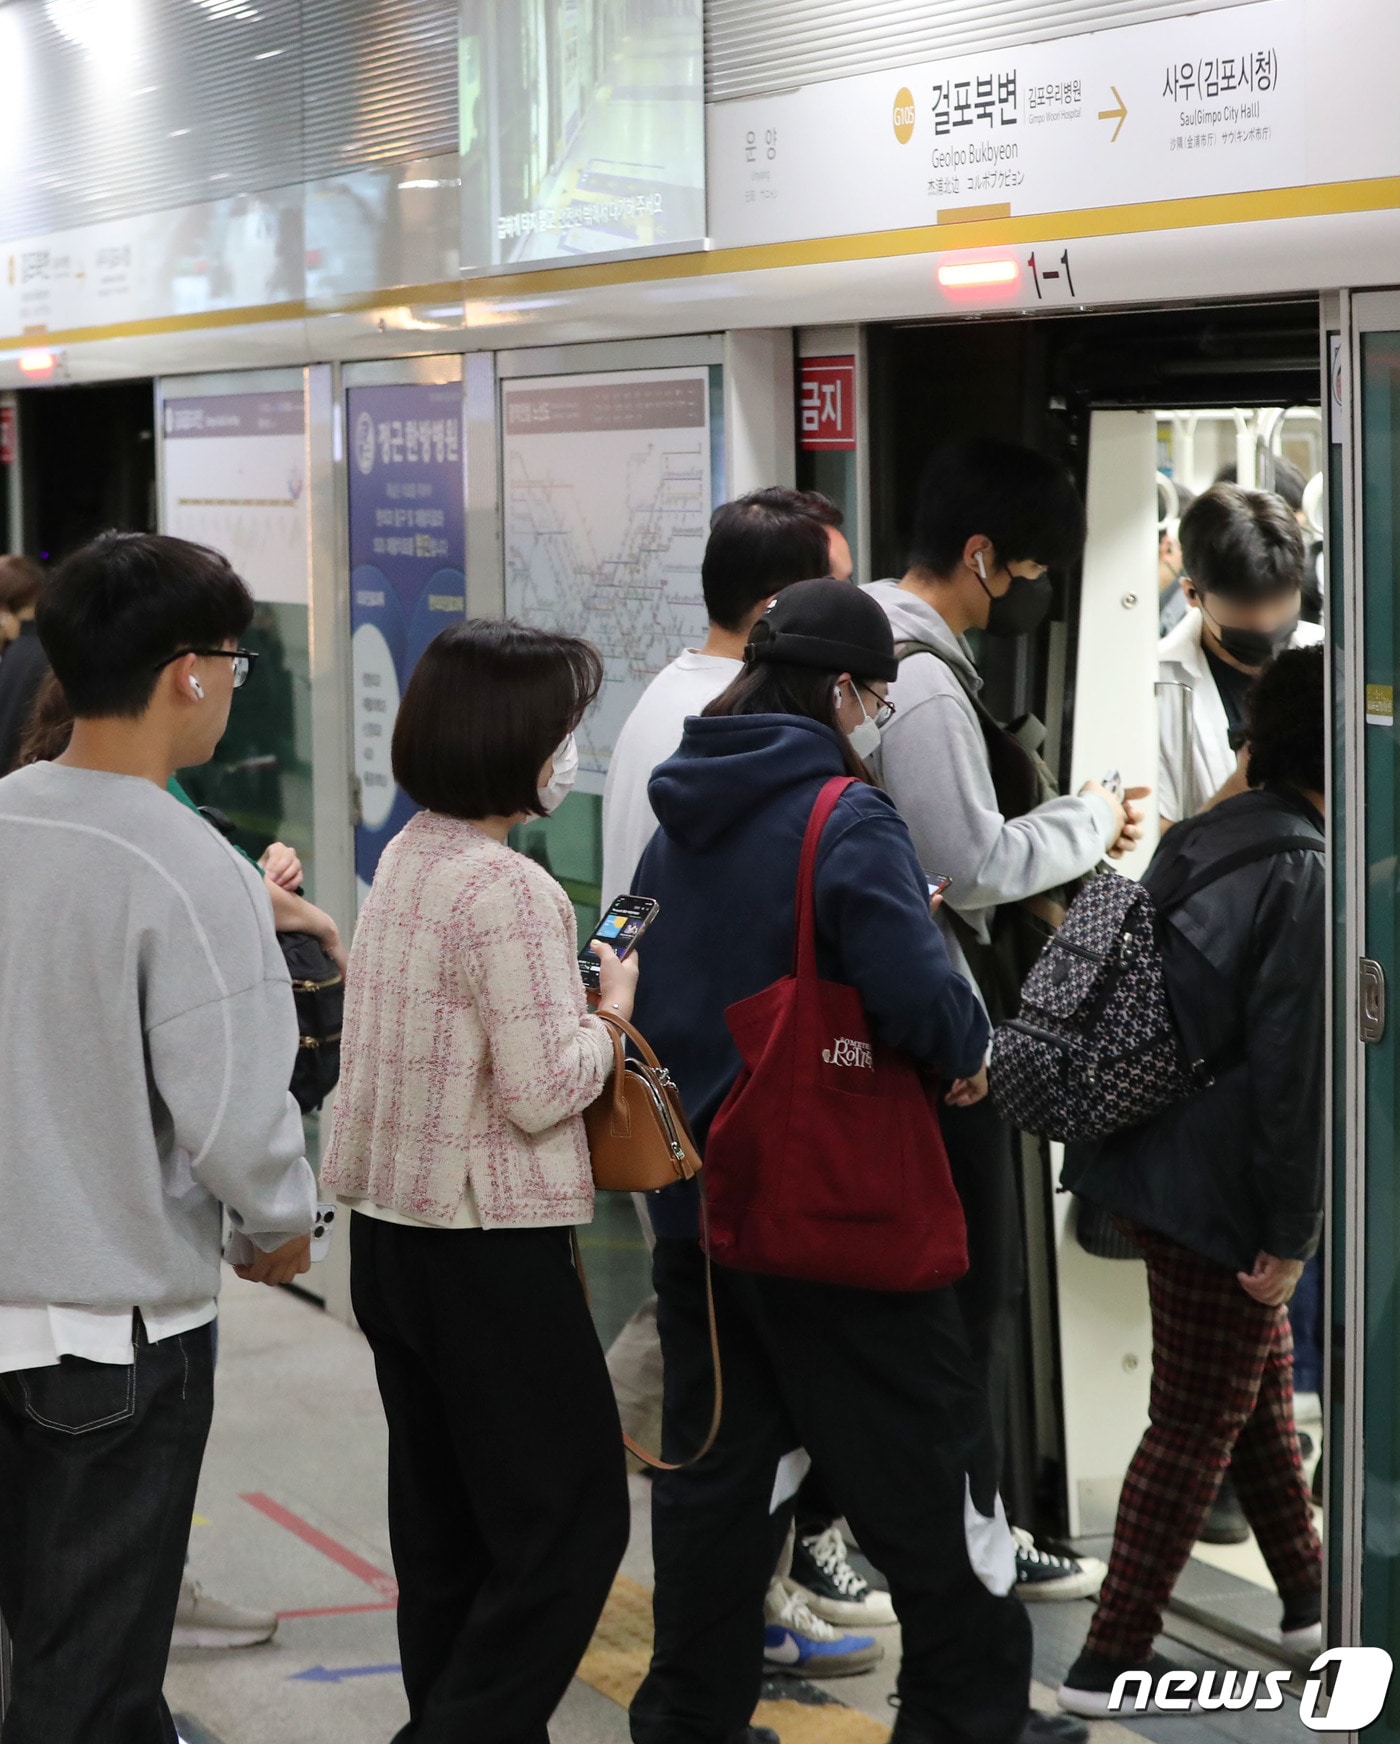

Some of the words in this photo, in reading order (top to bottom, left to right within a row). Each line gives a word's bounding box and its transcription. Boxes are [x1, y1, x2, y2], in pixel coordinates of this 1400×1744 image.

[1028, 79, 1082, 109] 김포우리병원
[1162, 47, 1278, 103] 사우(김포시청)
[894, 105, 916, 127] G105
[931, 68, 1018, 136] 걸포북변
[1223, 105, 1239, 124] City
[931, 145, 967, 172] Geolpo
[968, 140, 1019, 167] Bukbyeon
[1027, 248, 1076, 300] 1-1
[801, 379, 842, 432] 금지
